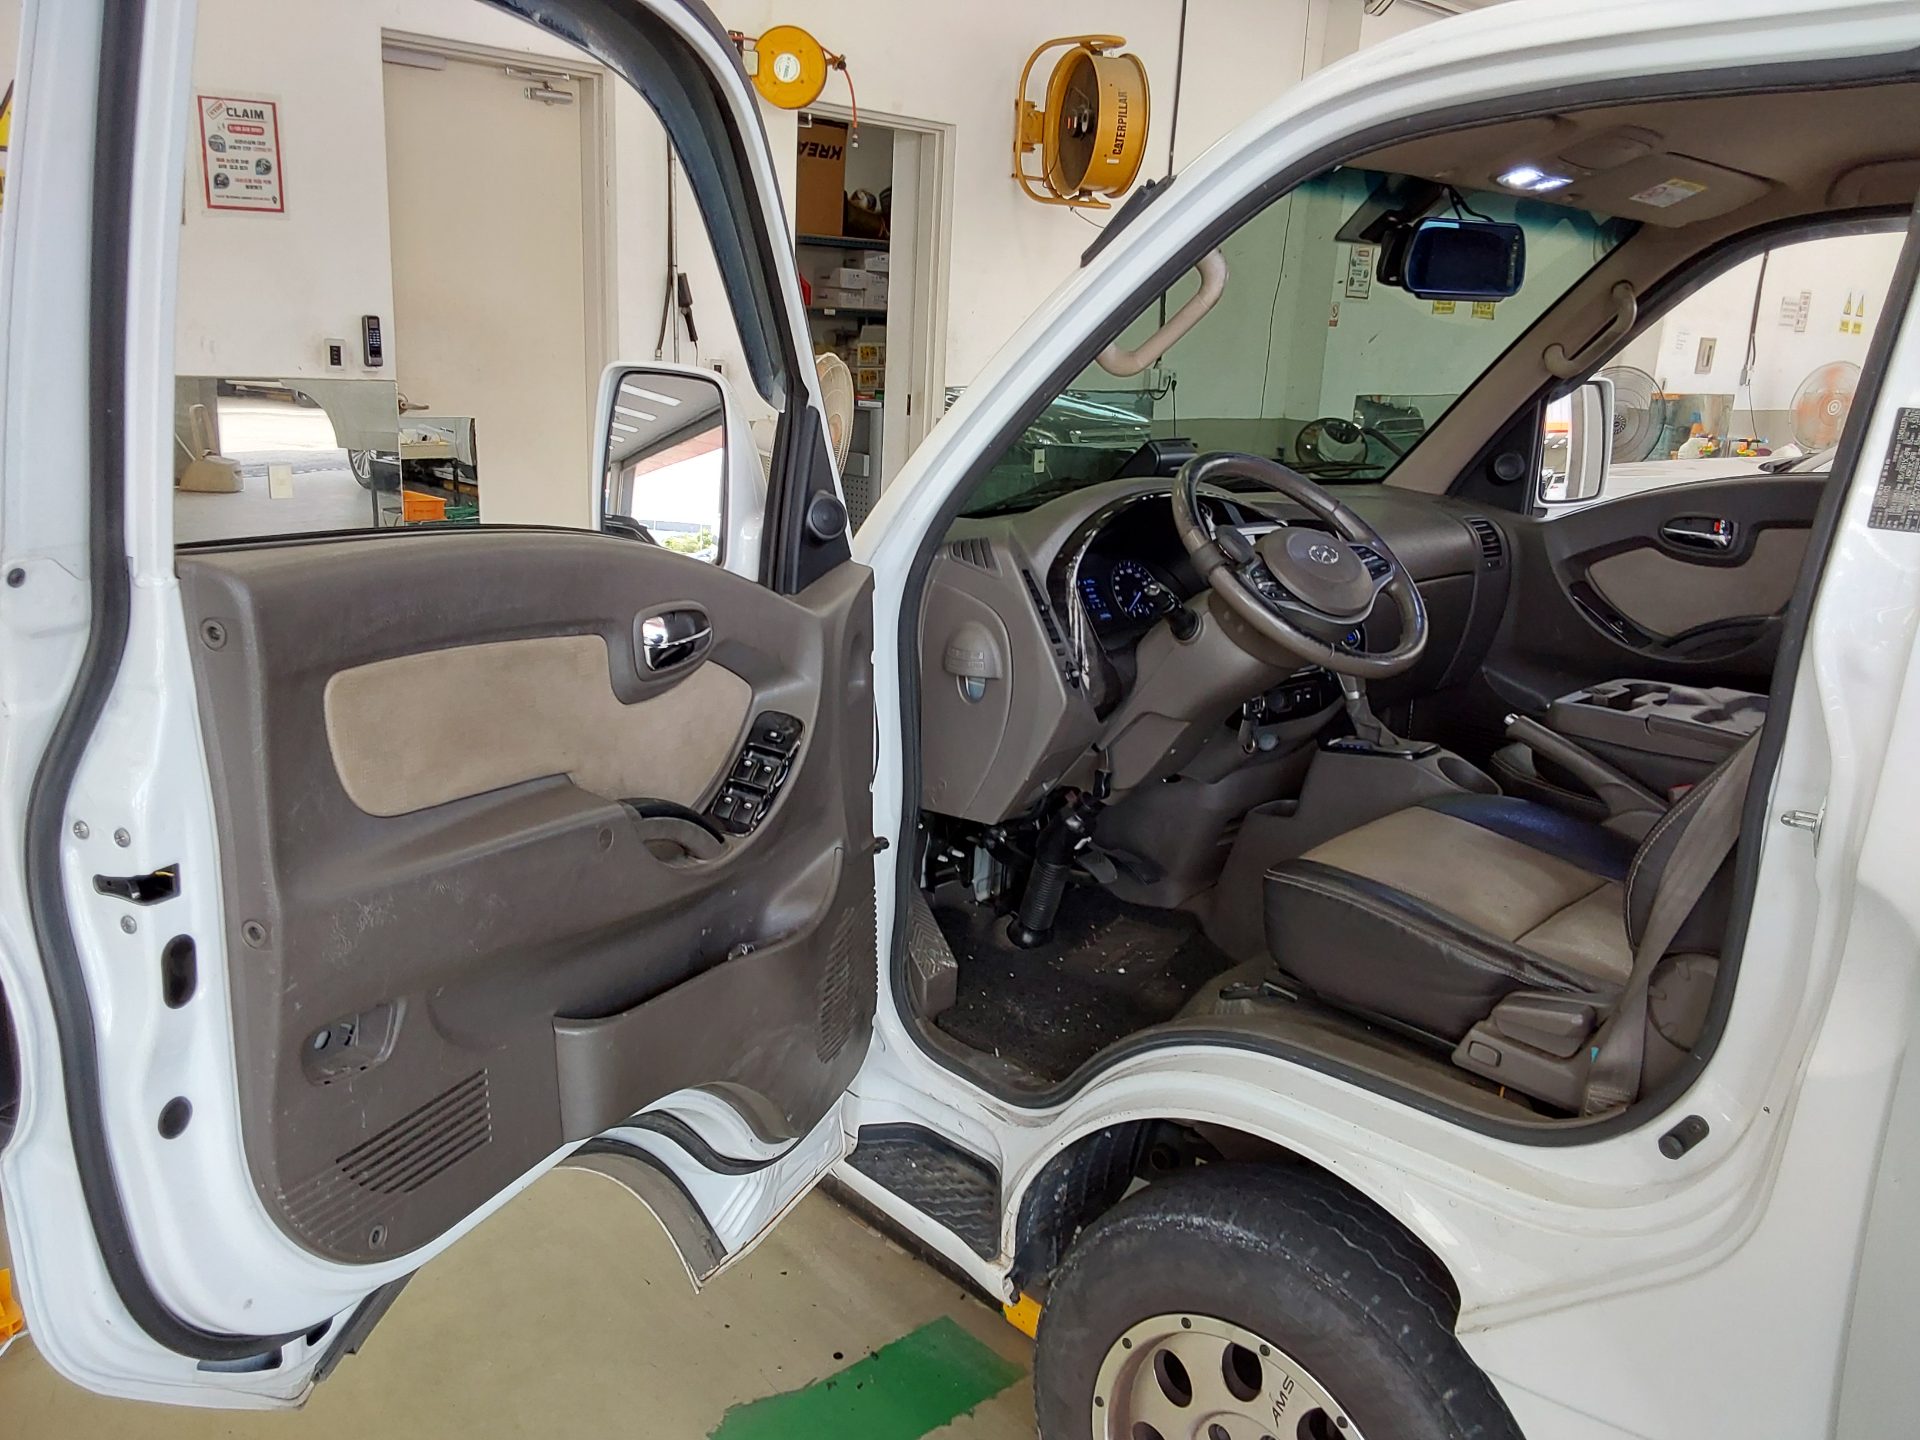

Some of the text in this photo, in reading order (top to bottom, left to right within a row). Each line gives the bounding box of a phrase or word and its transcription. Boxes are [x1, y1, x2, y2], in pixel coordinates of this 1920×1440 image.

[226, 107, 264, 120] CLAIM
[1112, 90, 1128, 155] CATERPILLAR
[1272, 1375, 1295, 1428] AMS
